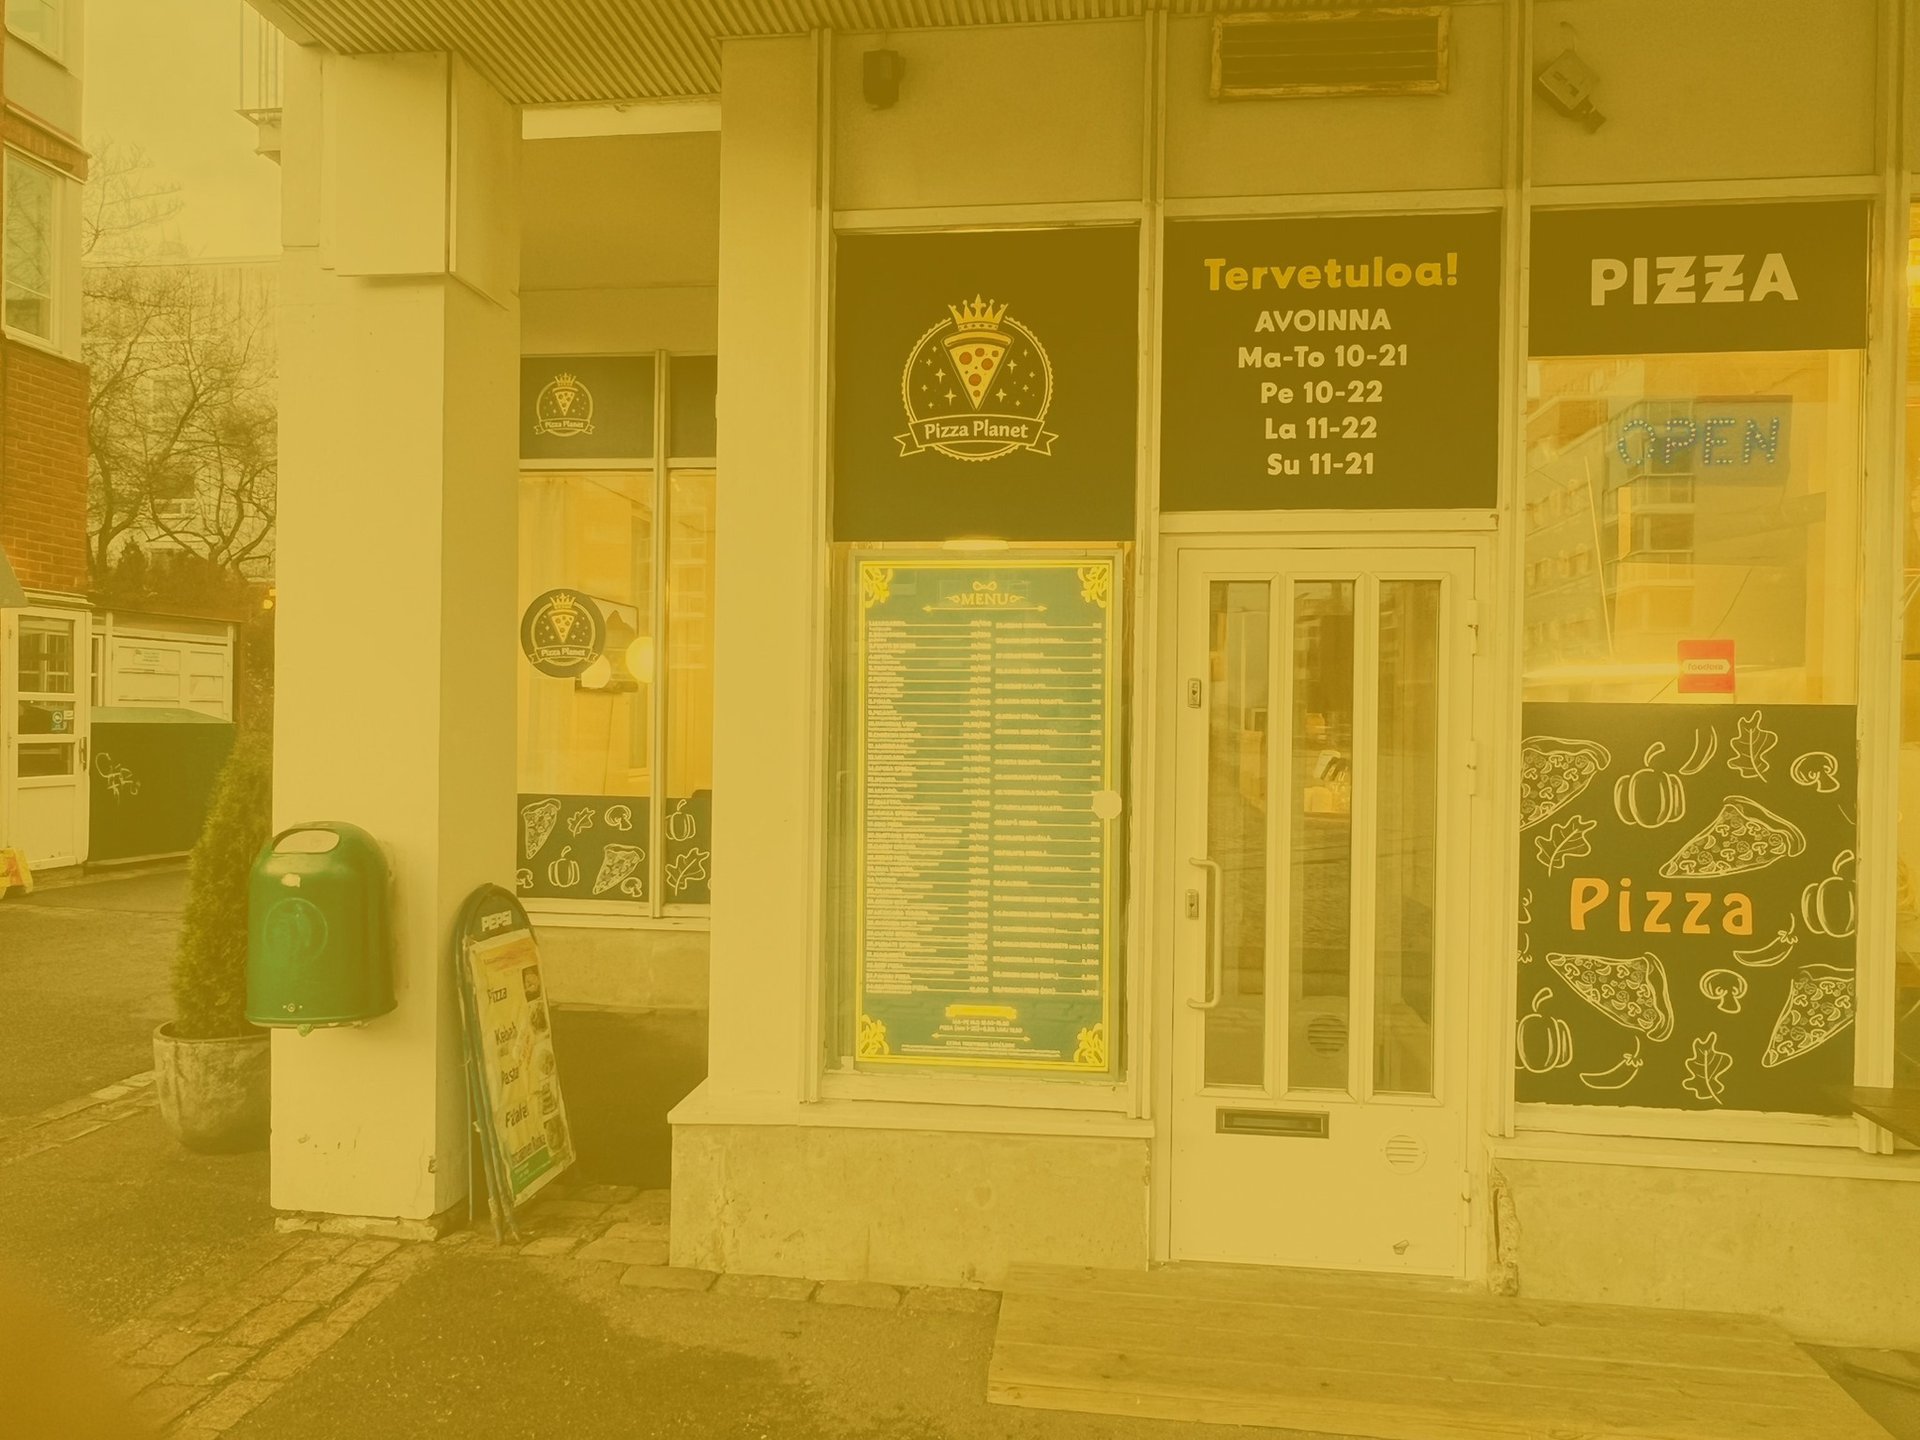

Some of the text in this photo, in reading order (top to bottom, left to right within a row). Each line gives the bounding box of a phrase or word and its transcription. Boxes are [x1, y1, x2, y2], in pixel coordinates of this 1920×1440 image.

[1204, 252, 1459, 292] Tervetuloa!
[1590, 252, 1799, 307] PIZZA
[1254, 308, 1392, 333] AVOINNA
[1237, 343, 1408, 369] Ma-To 10-21
[1260, 379, 1383, 405] Pe 10-22
[545, 419, 562, 430] Pizza
[924, 419, 1029, 440] Pizza Planet
[1265, 415, 1377, 440] La 11-22
[1617, 416, 1780, 466] OPEN
[1267, 451, 1374, 476] Su 11-21
[961, 593, 1010, 606] MENU
[541, 646, 585, 657] Pizza Planet
[1569, 876, 1755, 935] Pizza
[481, 910, 512, 932] PEPSI
